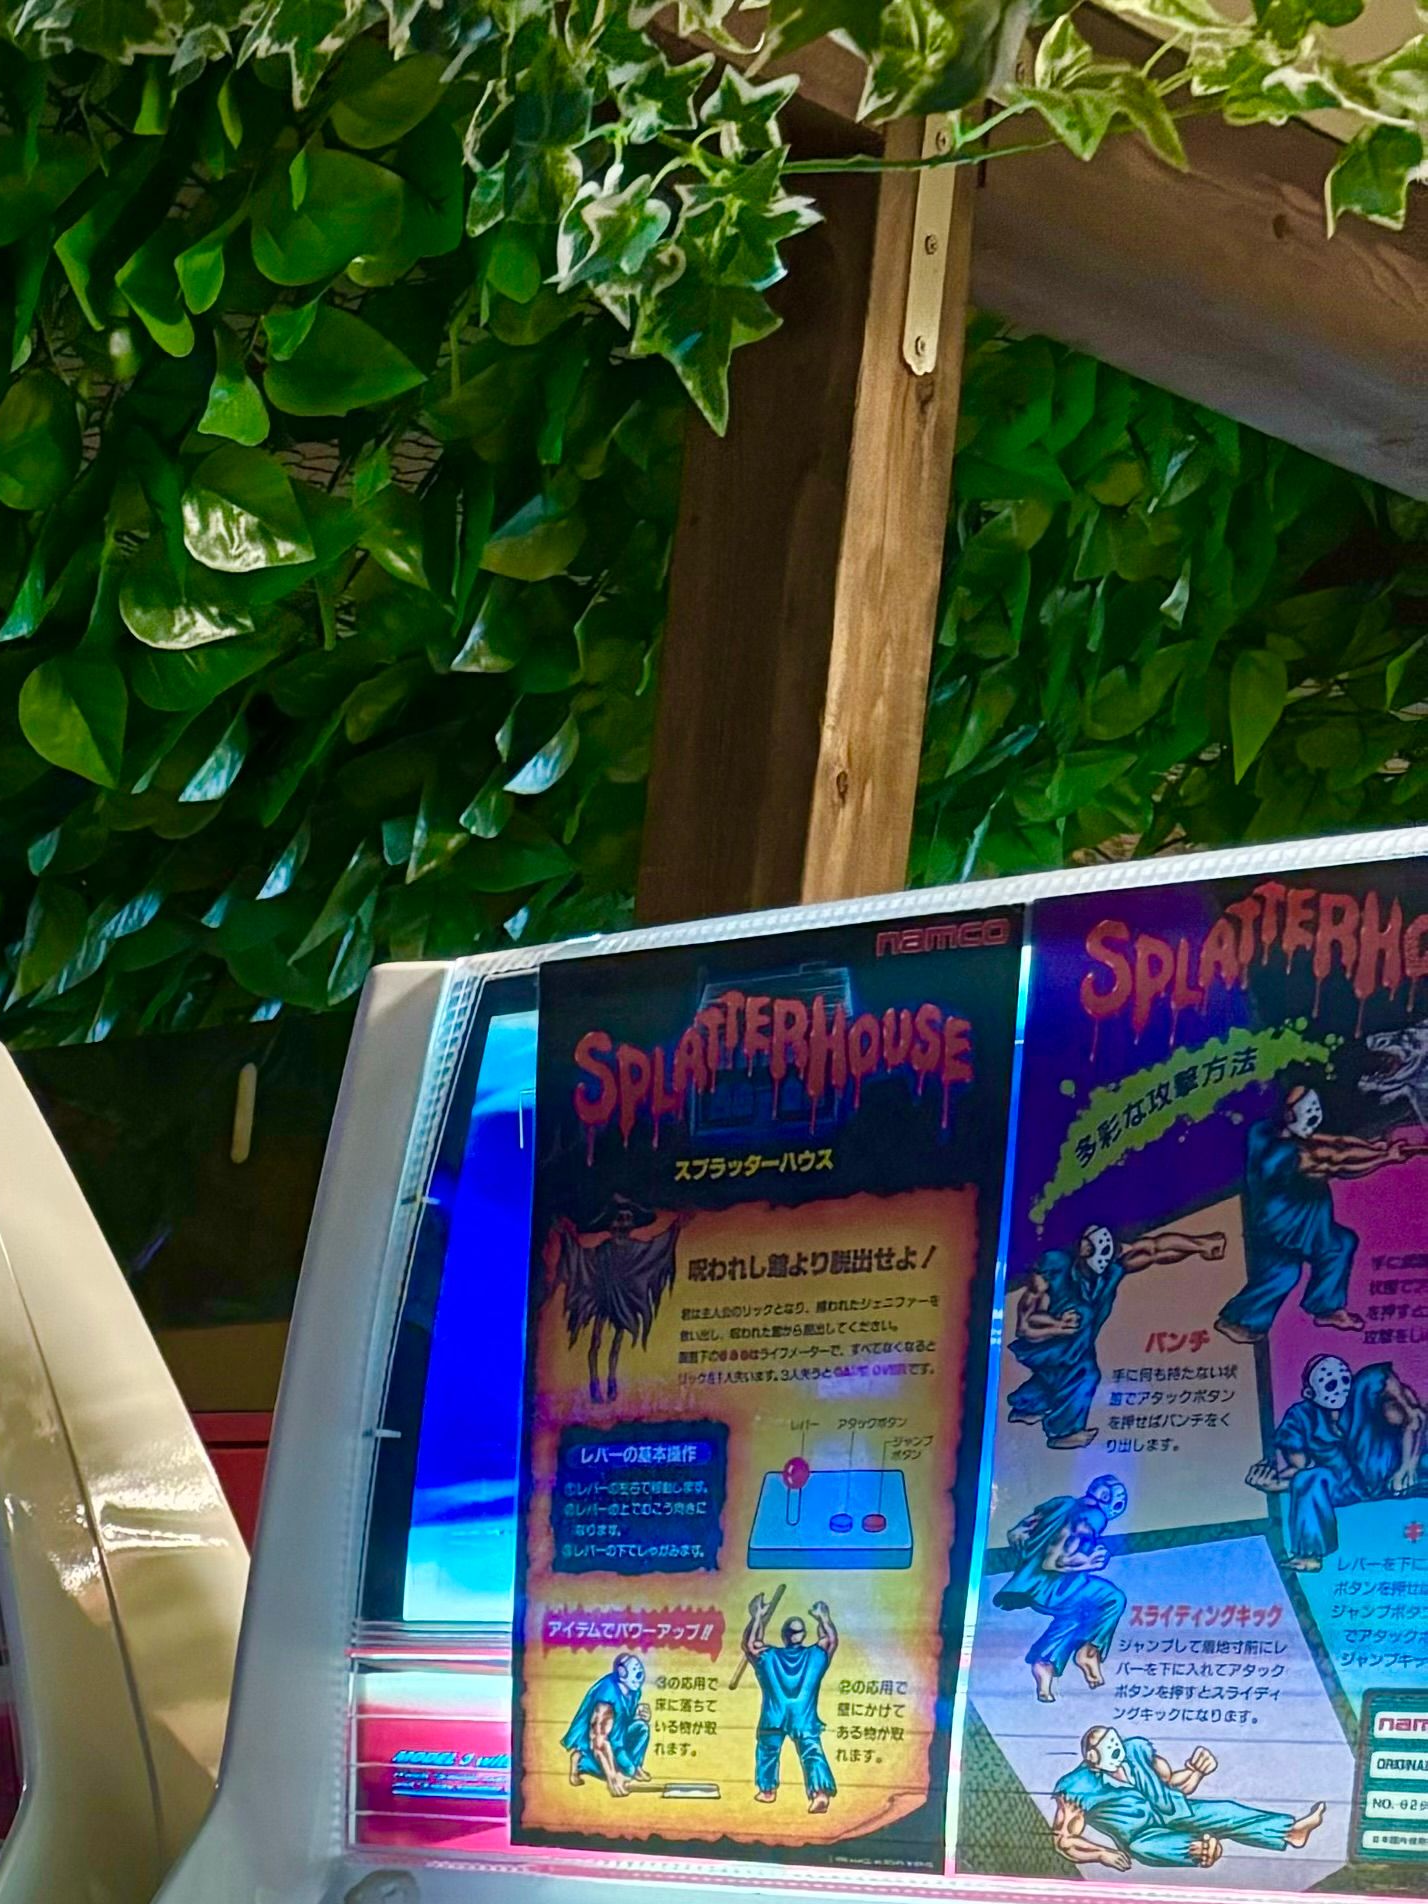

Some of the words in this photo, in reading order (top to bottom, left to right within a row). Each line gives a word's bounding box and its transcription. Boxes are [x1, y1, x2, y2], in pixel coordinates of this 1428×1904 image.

[875, 917, 1010, 957] namco
[1080, 880, 1428, 1040] SPLATTERHO
[573, 989, 974, 1155] SPLATTERHOUSE
[1074, 1046, 1259, 1169] 多彩な攻撃方法
[674, 1148, 834, 1182] スプラッターハウス
[1144, 1329, 1211, 1354] パンチ
[1111, 1364, 1238, 1383] 手に何も持たない状
[1109, 1388, 1235, 1407] 態でアタックボタン
[790, 1419, 820, 1431] レバー
[837, 1416, 908, 1430] アタックボタン
[1108, 1412, 1230, 1431] を押せばパンチをく
[581, 1444, 697, 1464] レバーの基本操作
[1106, 1437, 1181, 1454] り出します。
[889, 1448, 922, 1461] ボタン
[1337, 1556, 1428, 1573] レバーを下に
[1129, 1605, 1284, 1628] スライディングキック
[1119, 1638, 1288, 1655] ジャンプして着地寸前にレ
[1116, 1662, 1285, 1678] バーを下に入れてアタック
[1114, 1685, 1281, 1702] ボタンを押すとスライディ
[655, 1698, 718, 1713] 床に落ちて
[837, 1703, 906, 1718] 壁にかけて
[1112, 1709, 1259, 1725] ングキックになります。
[654, 1720, 718, 1736] いる物が取
[836, 1725, 905, 1741] ある物が取
[654, 1742, 698, 1757] れます。
[835, 1748, 884, 1763] れます。
